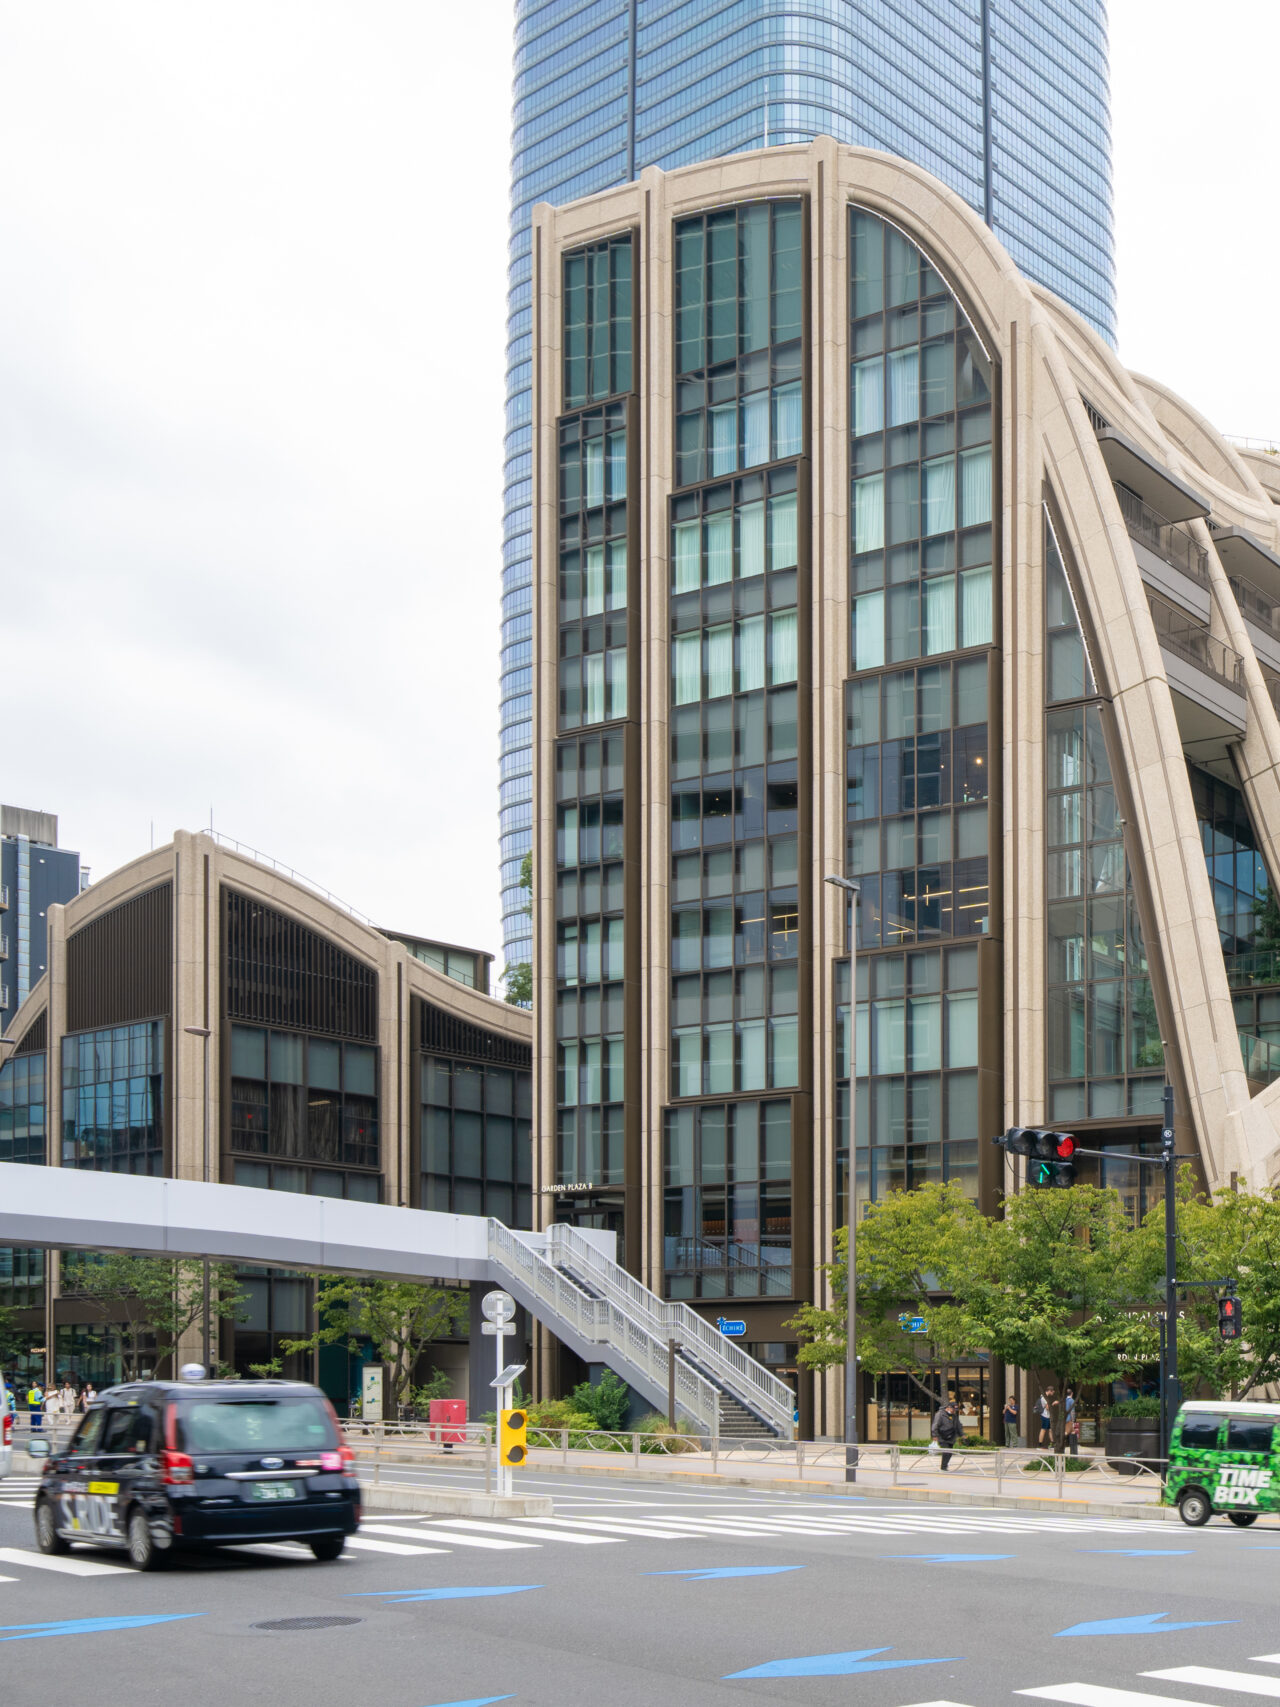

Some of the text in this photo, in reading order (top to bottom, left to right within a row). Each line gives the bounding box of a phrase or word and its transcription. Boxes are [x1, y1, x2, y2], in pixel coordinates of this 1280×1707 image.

[541, 1184, 566, 1192] GARDEN
[567, 1183, 587, 1191] PLAZA
[1218, 1468, 1273, 1488] TIME
[1213, 1486, 1260, 1506] BOX
